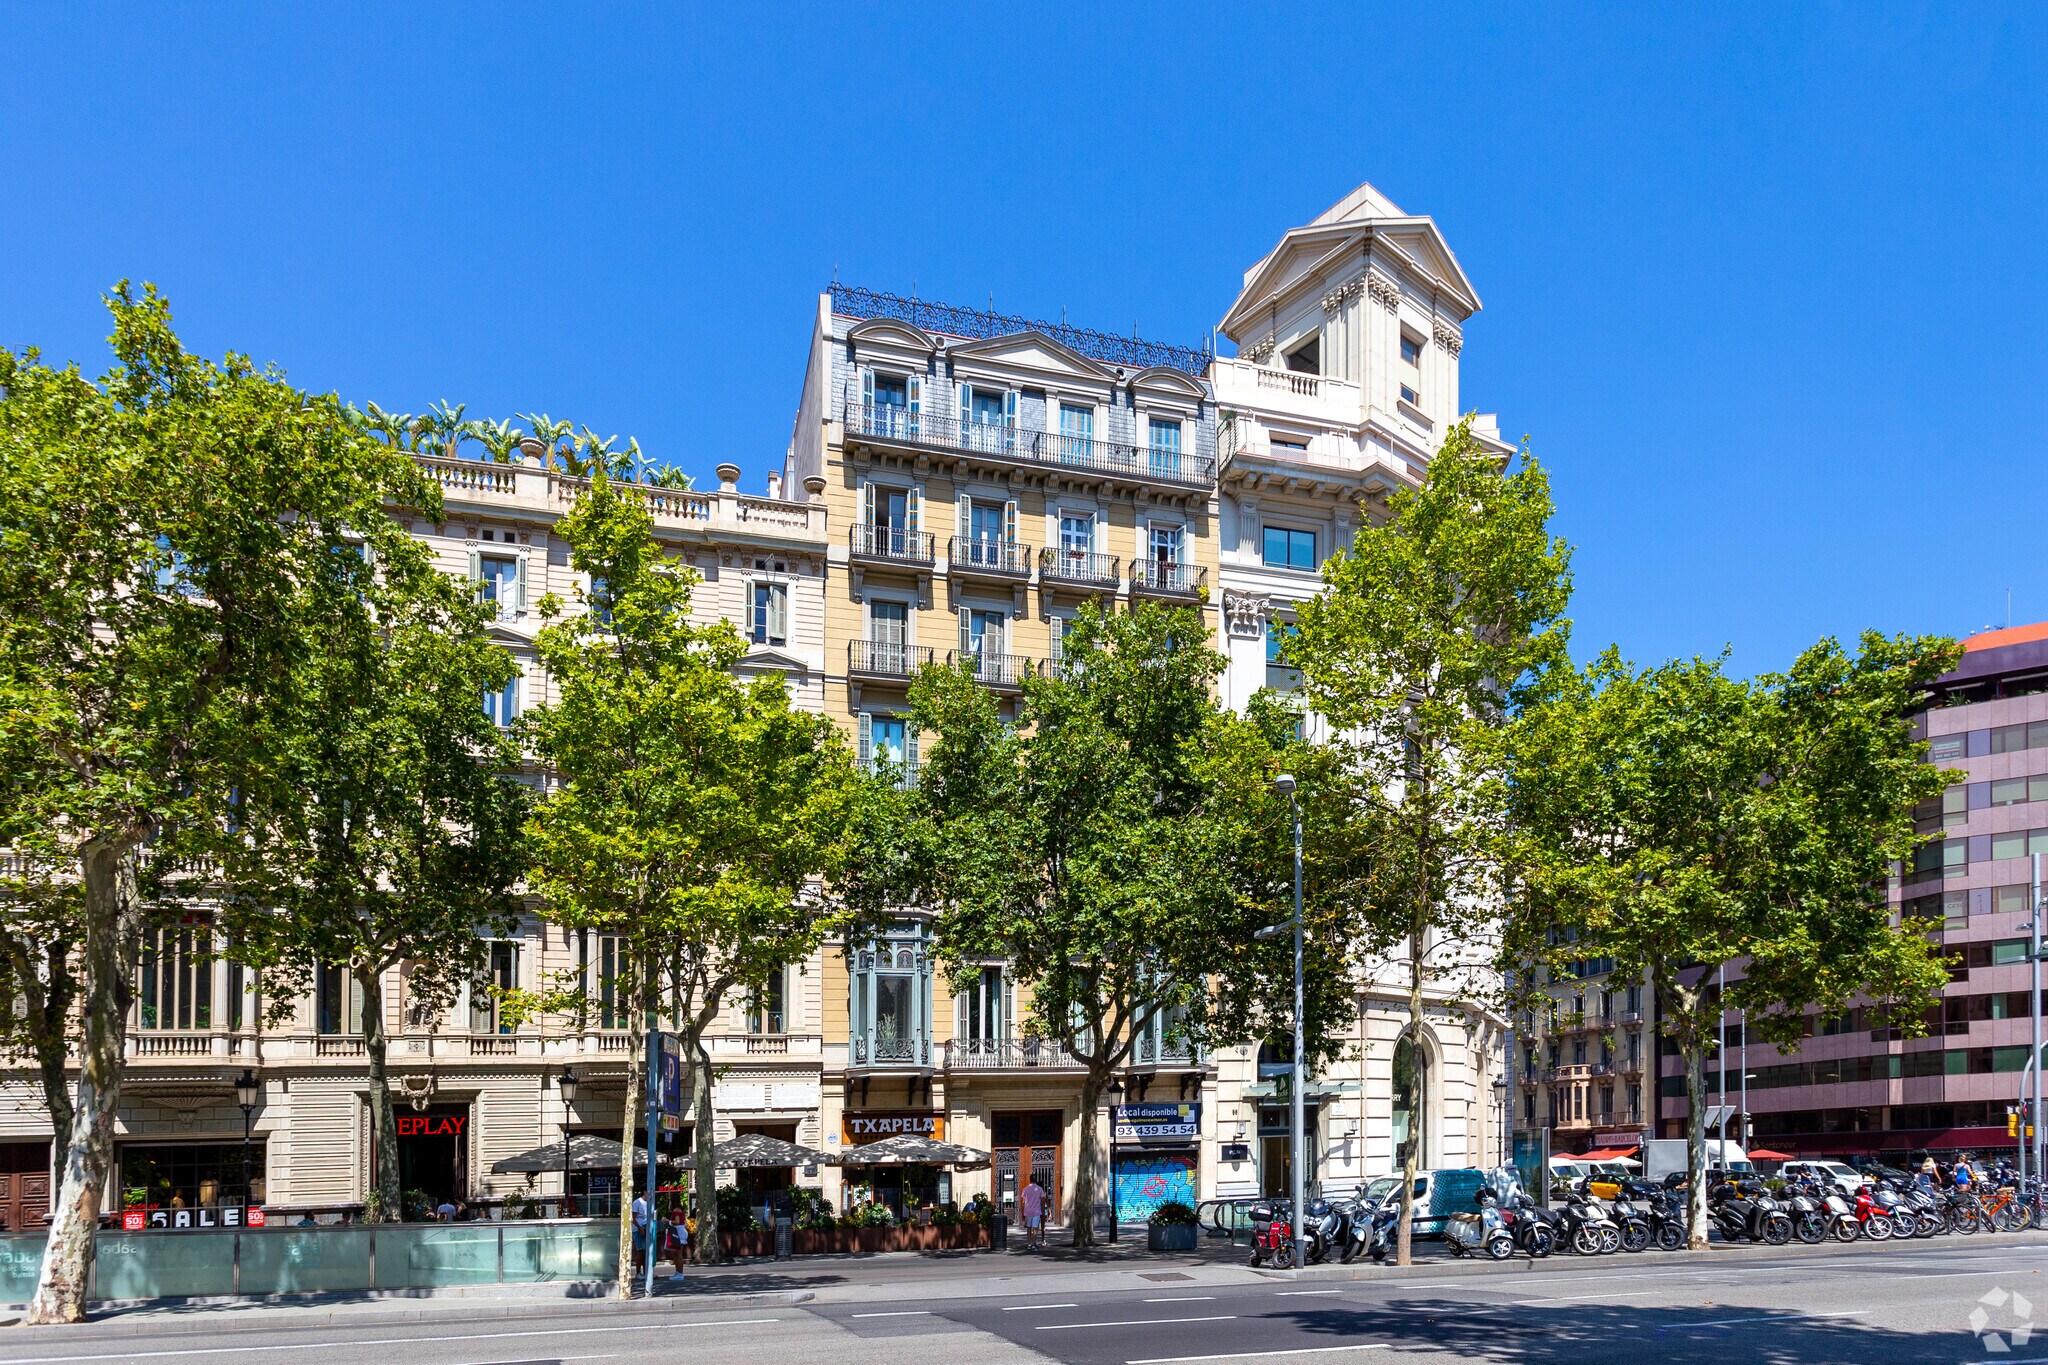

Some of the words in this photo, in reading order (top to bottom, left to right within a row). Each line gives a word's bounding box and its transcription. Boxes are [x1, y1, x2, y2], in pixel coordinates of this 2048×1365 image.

[1118, 1108, 1140, 1117] Local
[1141, 1108, 1178, 1118] disponible
[396, 1117, 467, 1135] EPLAY
[851, 1118, 935, 1133] TXAPELA
[1117, 1126, 1133, 1136] 93
[1136, 1126, 1159, 1135] 439
[1162, 1126, 1177, 1134] 54
[1180, 1125, 1195, 1134] 54
[735, 1159, 778, 1167] TXAPELA
[152, 1209, 239, 1228] SALE
